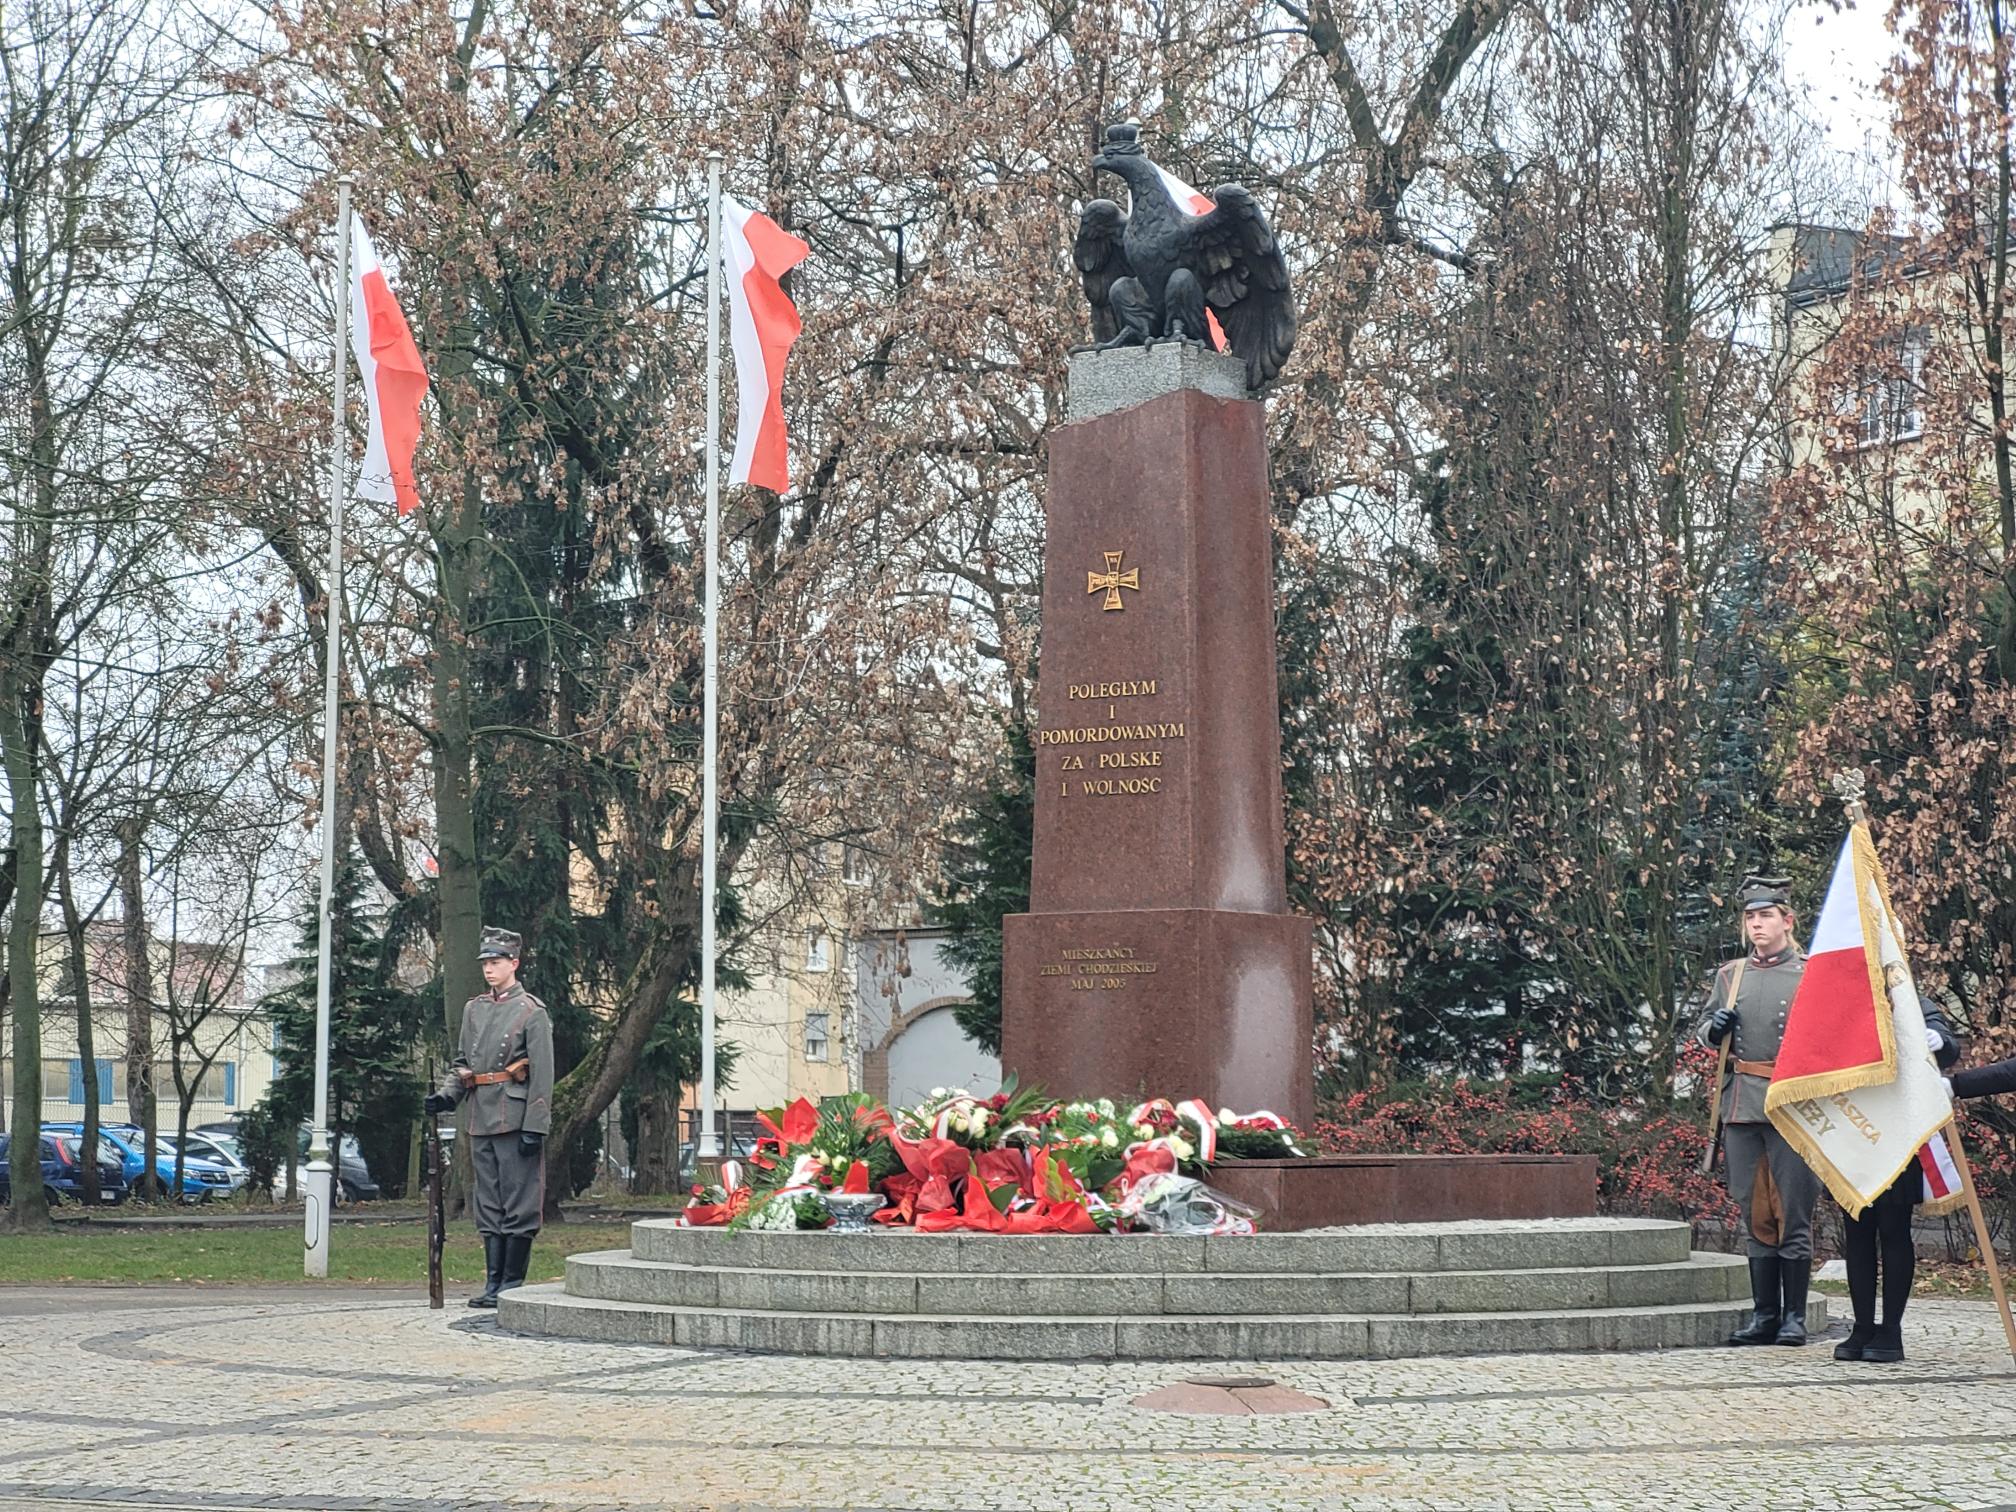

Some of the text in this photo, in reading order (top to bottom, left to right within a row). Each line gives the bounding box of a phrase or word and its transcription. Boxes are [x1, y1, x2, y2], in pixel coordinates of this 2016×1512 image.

[1069, 680, 1157, 699] POLEGŁYM
[1109, 705, 1115, 719] I
[1040, 723, 1185, 745] POMORDOWANYM
[1061, 756, 1084, 770] ZA
[1062, 783, 1068, 797] I
[1071, 979, 1094, 991] MAJ
